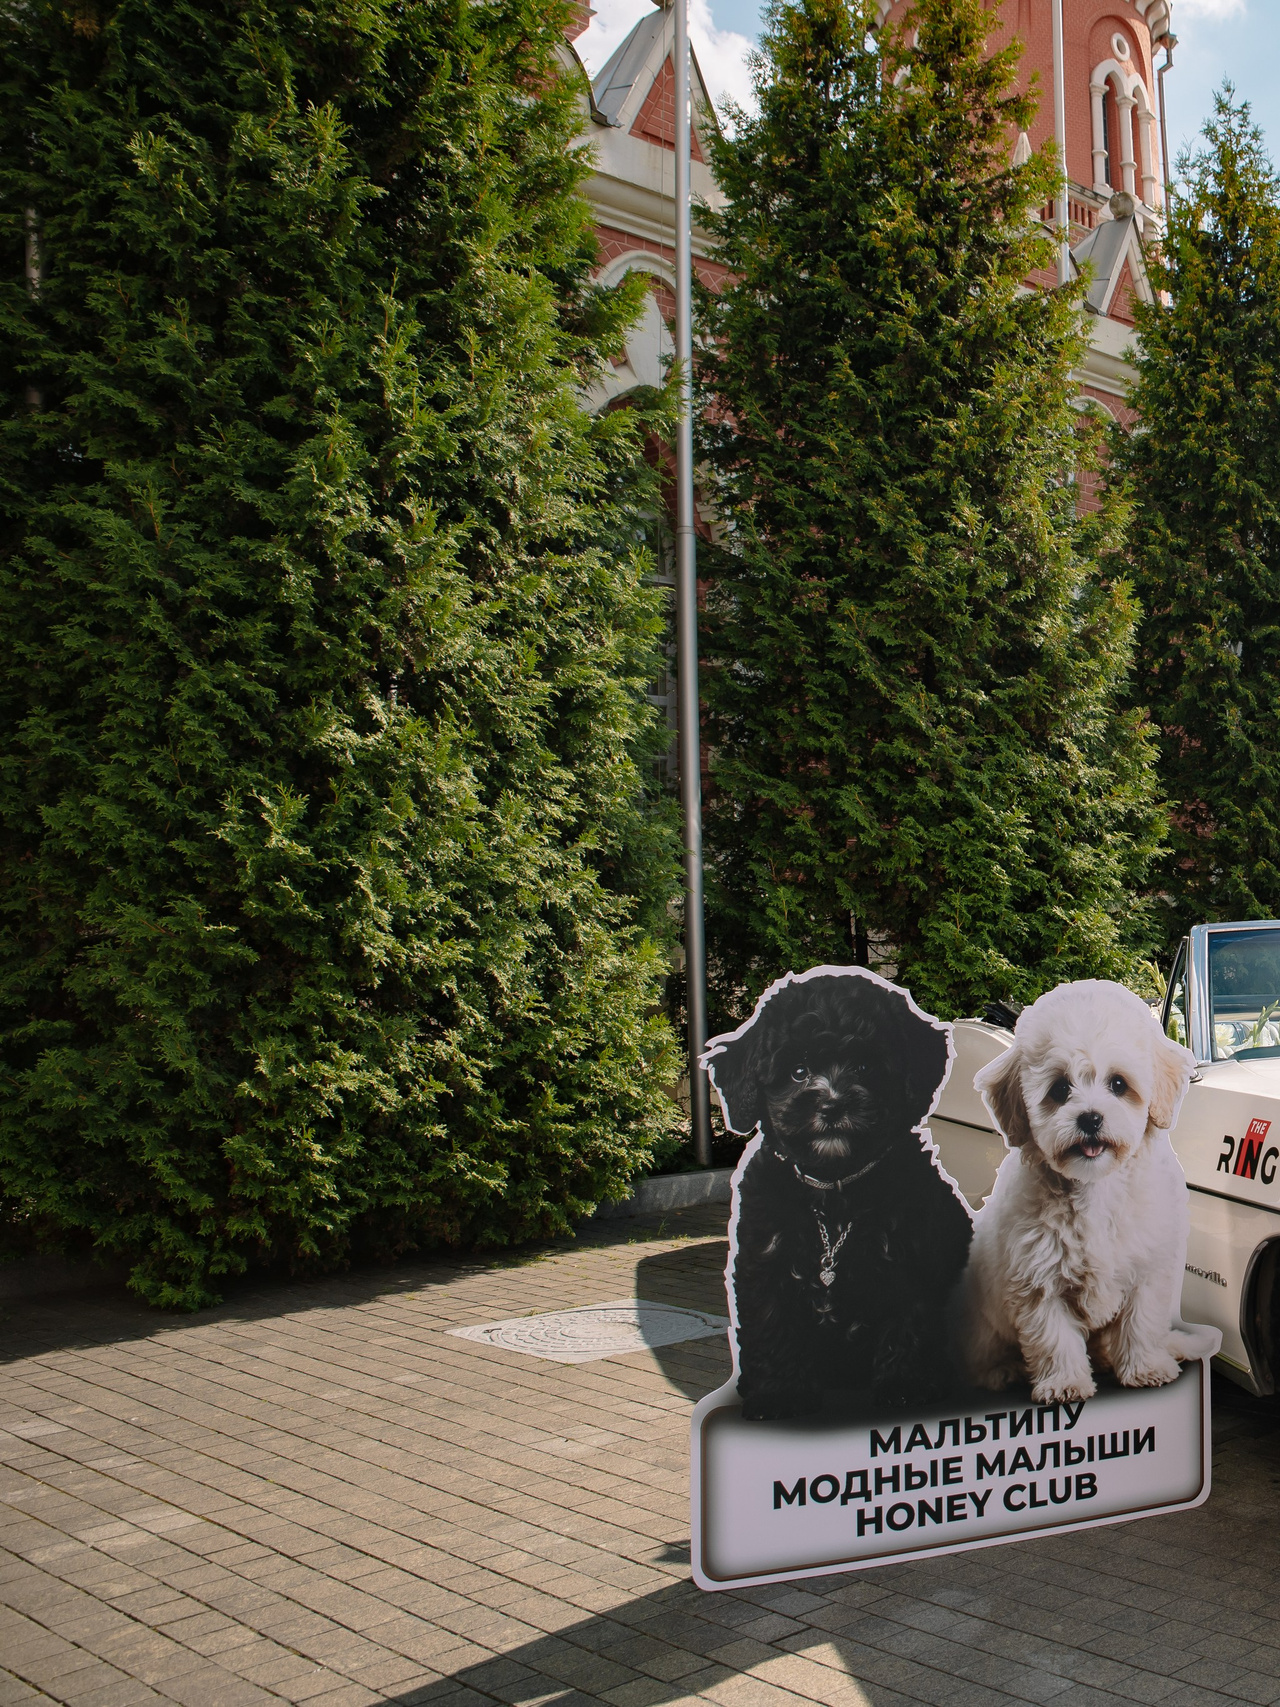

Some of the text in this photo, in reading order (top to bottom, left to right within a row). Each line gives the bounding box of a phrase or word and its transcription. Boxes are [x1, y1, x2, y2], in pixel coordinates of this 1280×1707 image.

[1250, 1120, 1268, 1135] THE
[1216, 1134, 1280, 1185] RING
[869, 1400, 1086, 1458] МАЛЬТИПУ
[772, 1426, 1156, 1510] МОДНЫЕ МАЛЫШИ
[856, 1472, 1099, 1538] HONEY CLUB
